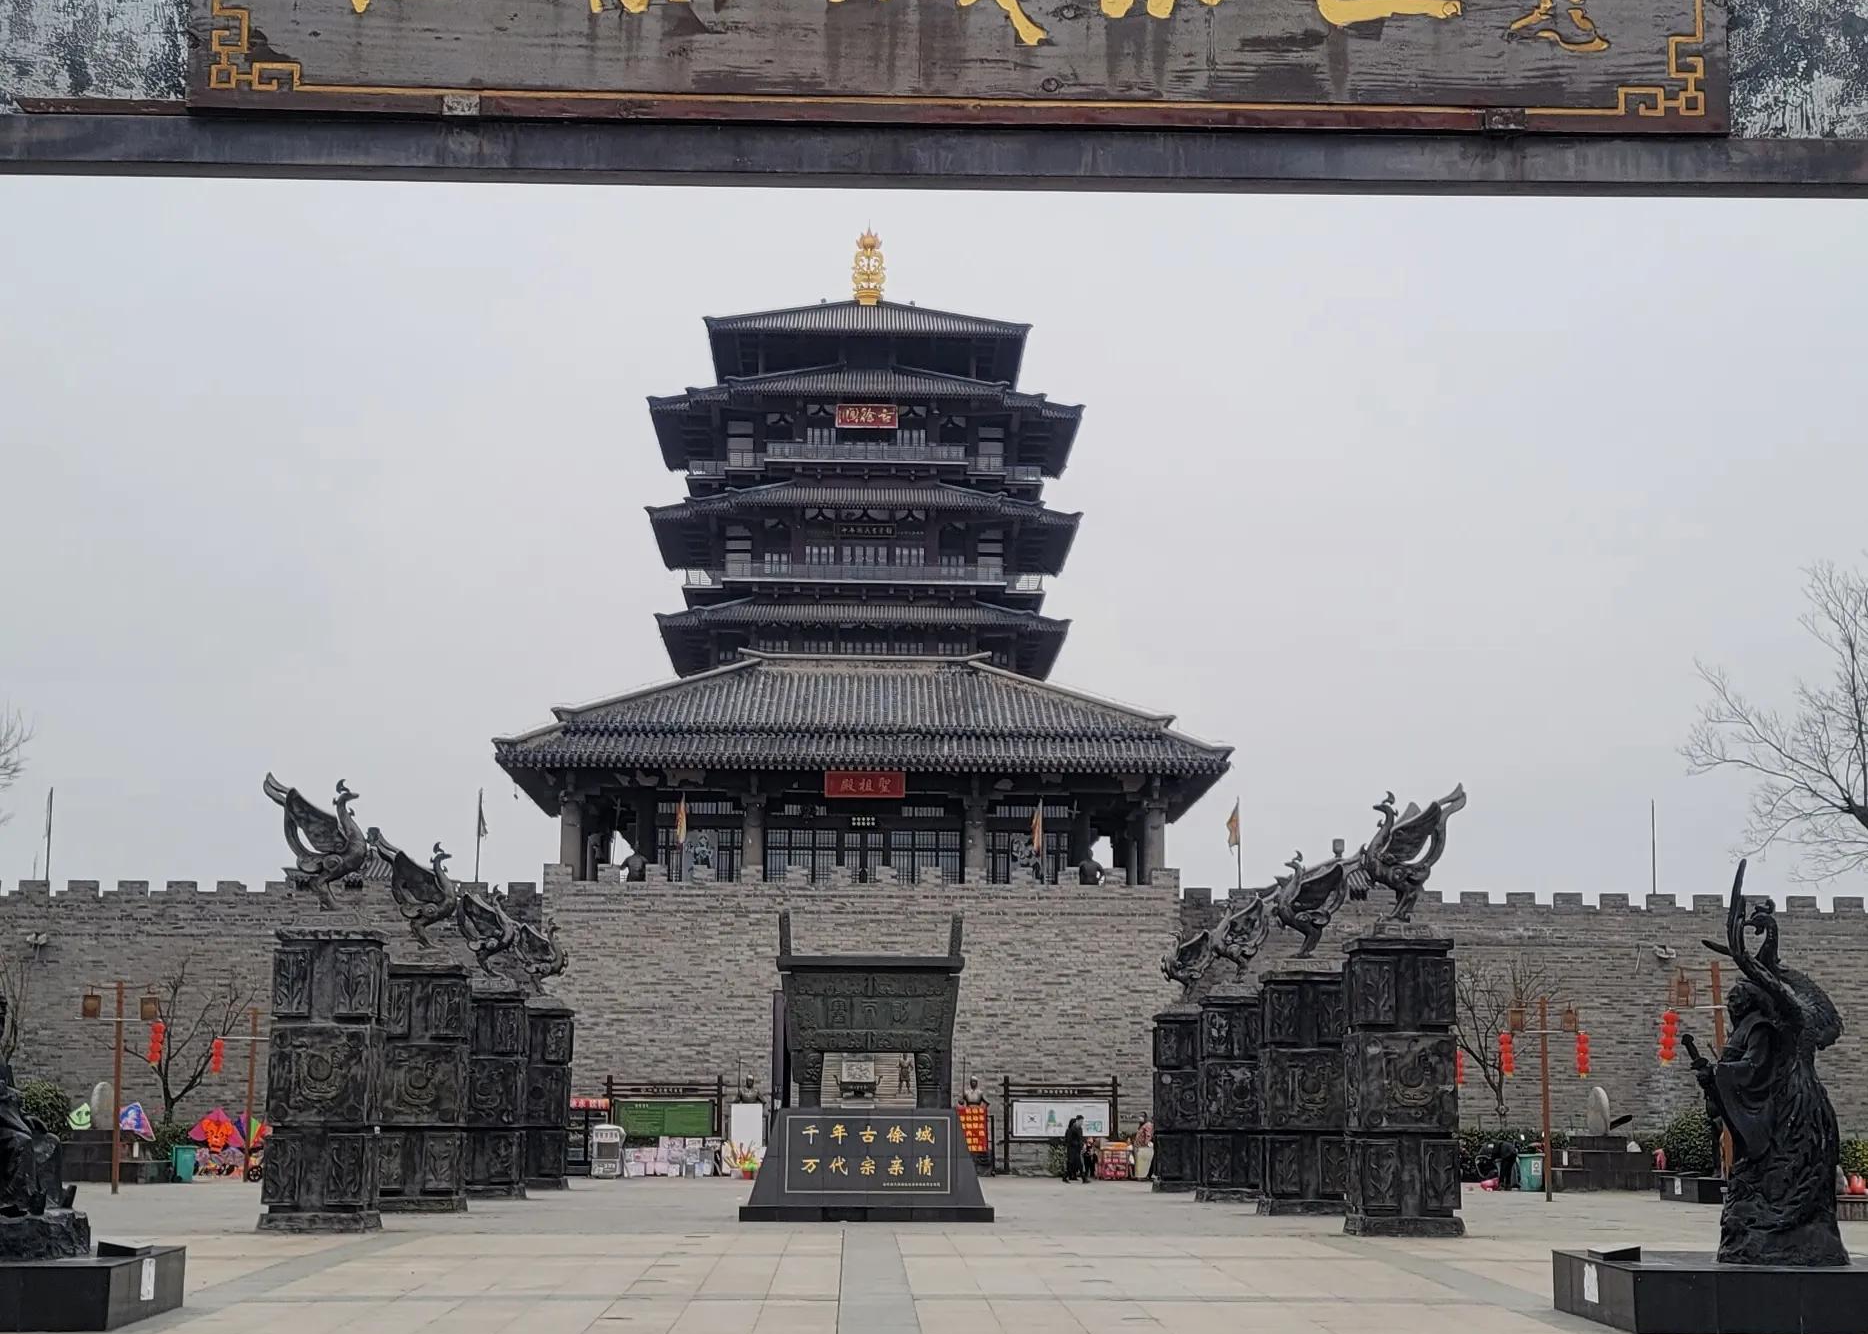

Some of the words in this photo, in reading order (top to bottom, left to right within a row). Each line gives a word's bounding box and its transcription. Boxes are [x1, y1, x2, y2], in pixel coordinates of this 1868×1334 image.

[802, 1123, 936, 1145] 千年古徐城
[801, 1154, 935, 1176] 万代宗亲情
